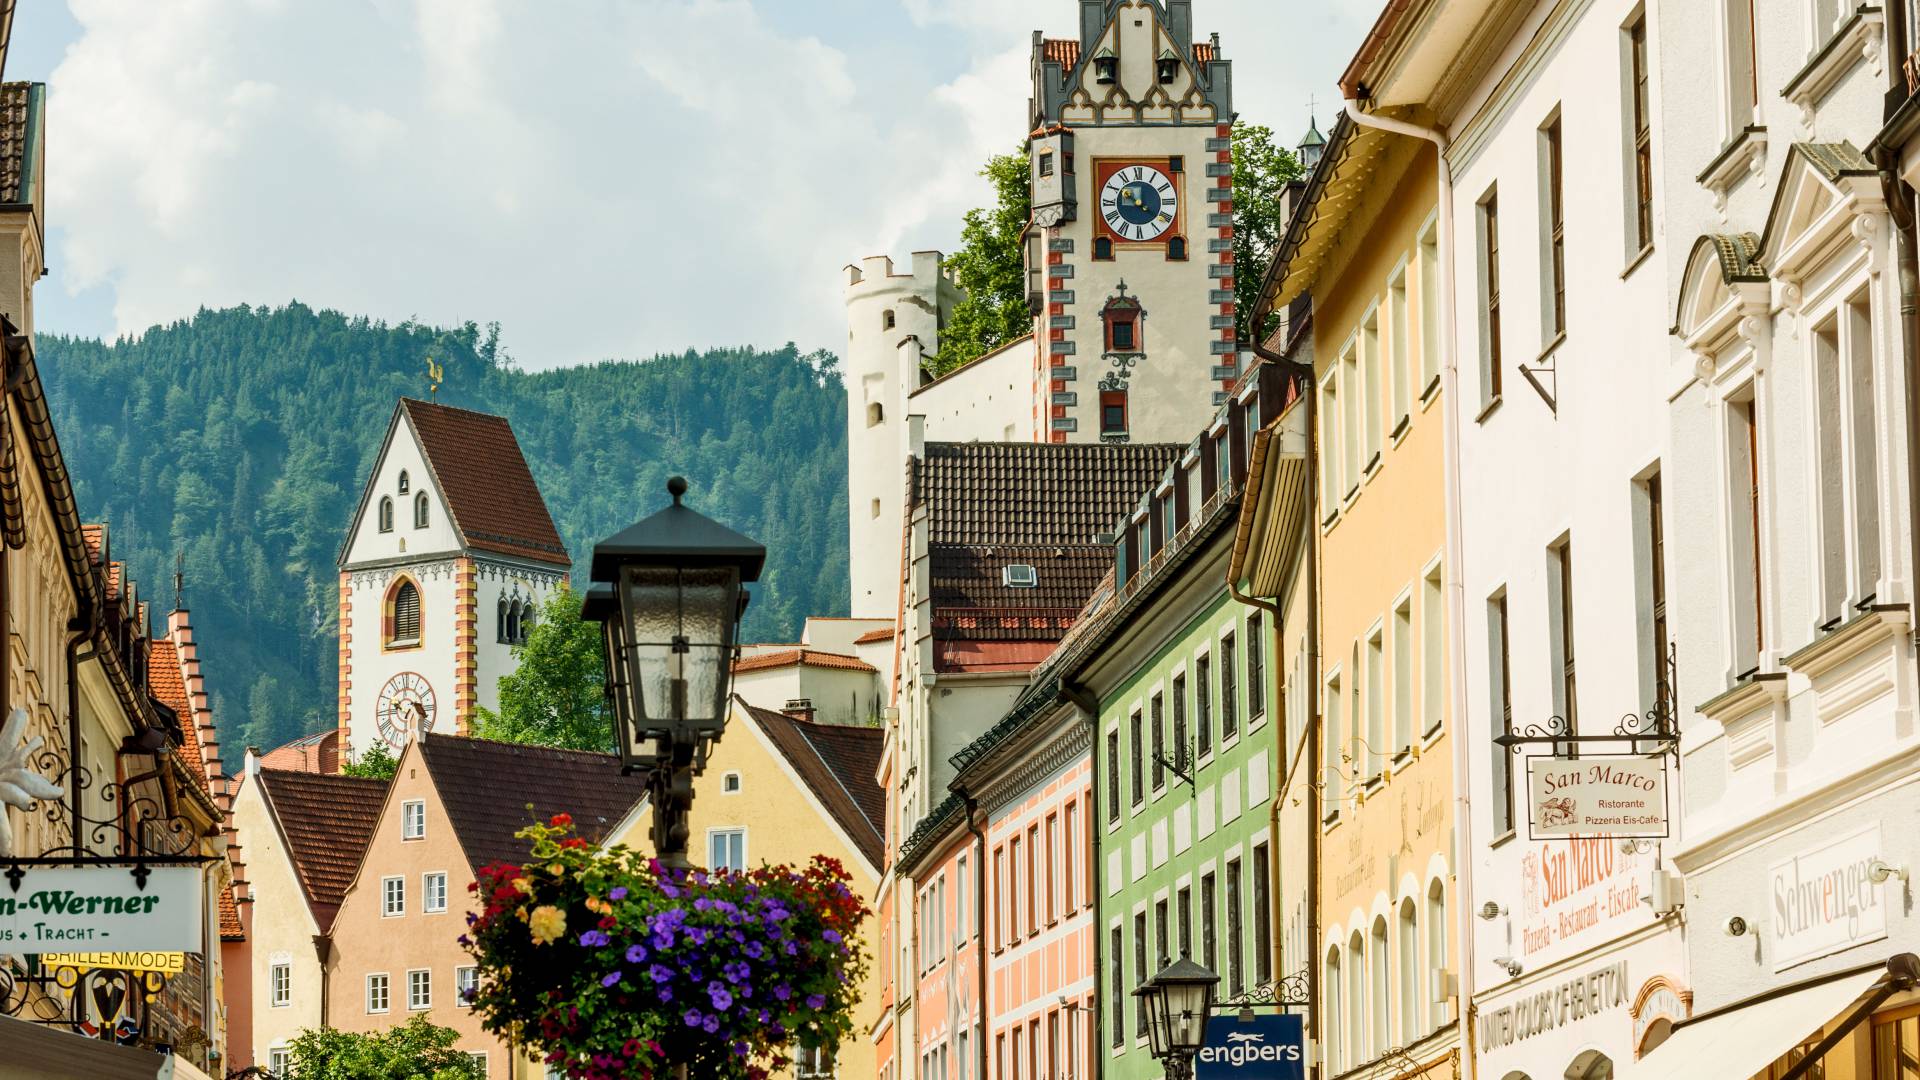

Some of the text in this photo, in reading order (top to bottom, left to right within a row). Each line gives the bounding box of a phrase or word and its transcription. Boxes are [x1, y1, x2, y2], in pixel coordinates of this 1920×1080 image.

[1117, 171, 1130, 185] XI
[1133, 167, 1143, 181] XII
[1149, 171, 1157, 183] I
[1106, 182, 1120, 194] X
[1157, 182, 1171, 193] II
[1150, 222, 1162, 236] V
[1544, 765, 1655, 795] San Marco
[1598, 799, 1645, 809] Ristorante
[1585, 815, 1659, 825] Pizzeria Eis-Cafe
[1542, 832, 1613, 908] San Marco
[0, 890, 160, 916] n-Werner
[34, 922, 95, 941] TRACHT
[1523, 918, 1551, 957] Pizzeria
[1559, 895, 1599, 941] Restaurant
[1480, 1005, 1514, 1053] UNITED
[1515, 989, 1554, 1041] COLORS
[1554, 983, 1569, 1028] OF
[1570, 960, 1629, 1021] BENETTON
[1199, 1040, 1300, 1067] engbers
